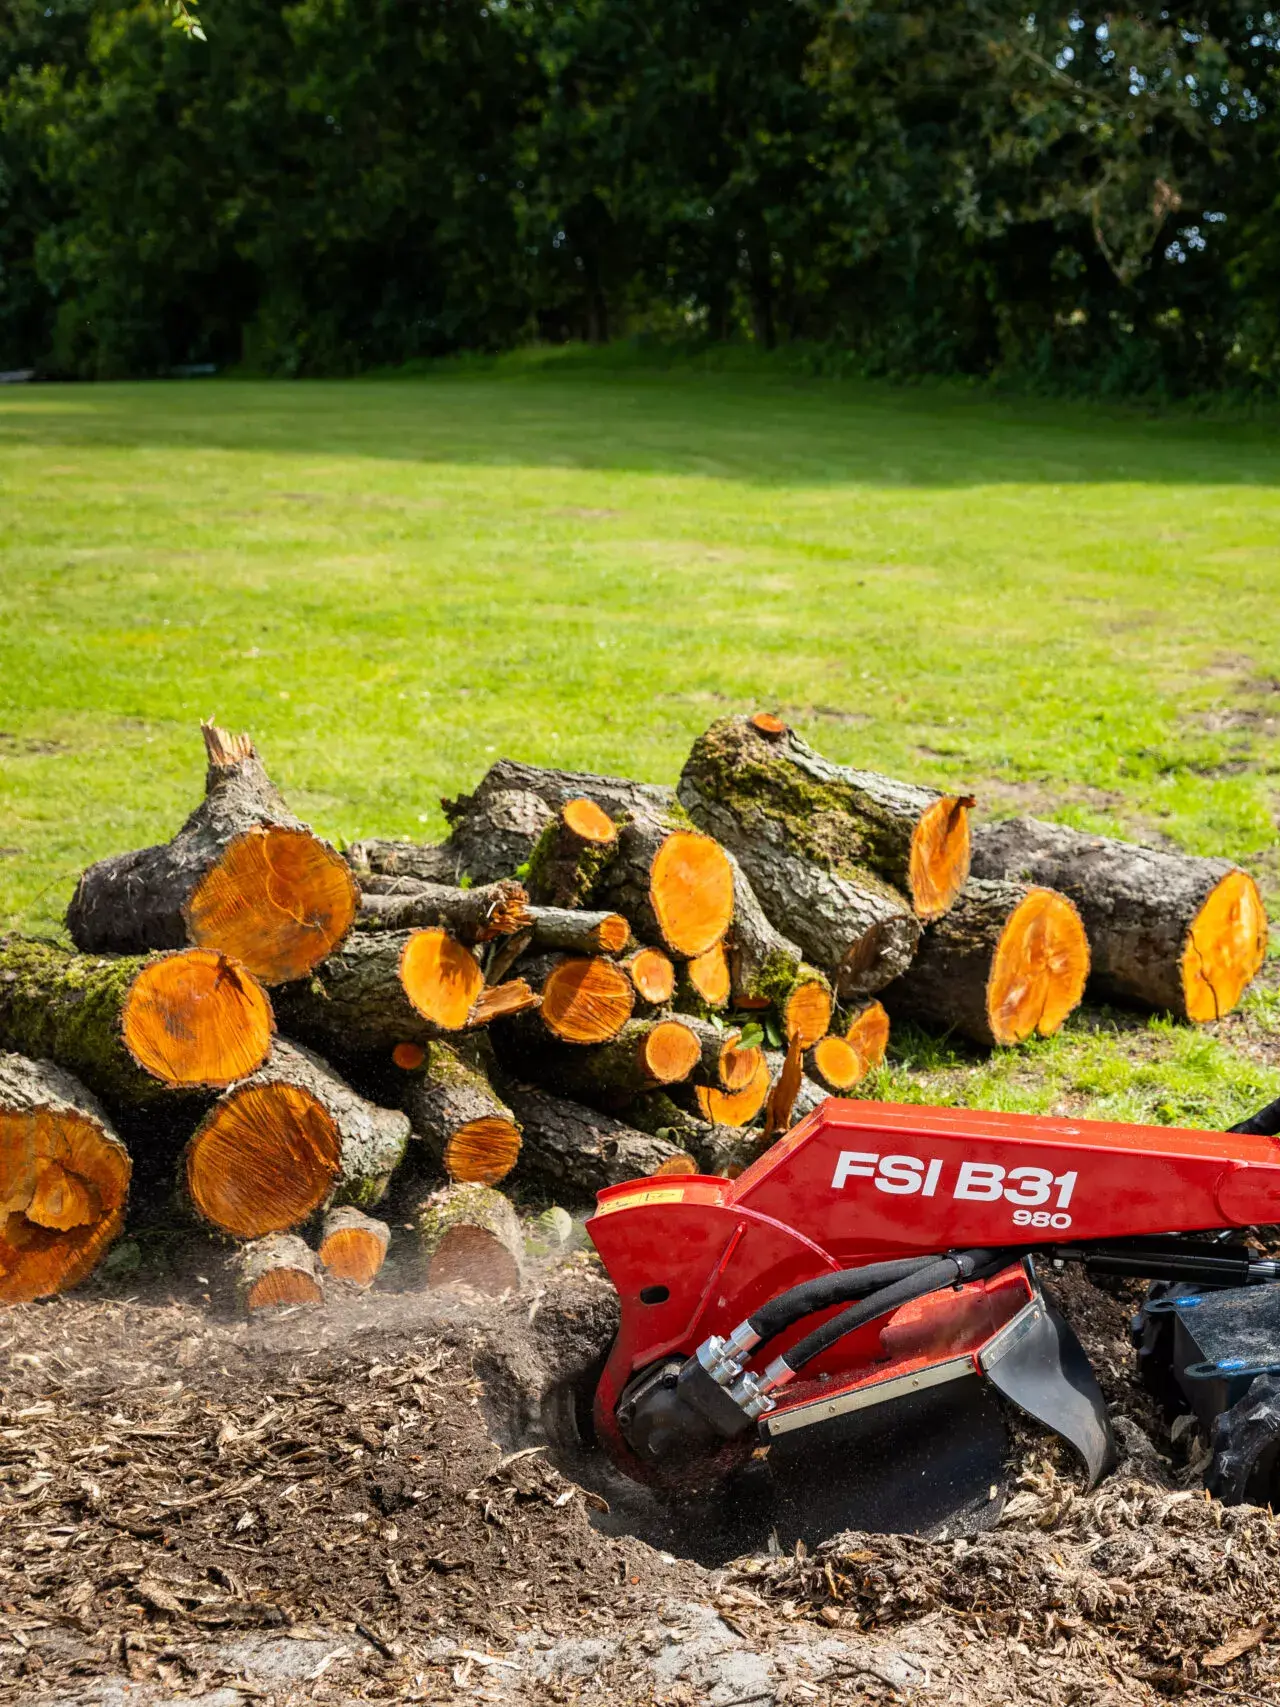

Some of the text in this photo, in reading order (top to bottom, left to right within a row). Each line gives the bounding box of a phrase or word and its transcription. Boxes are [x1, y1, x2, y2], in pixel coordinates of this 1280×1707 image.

[831, 1151, 1078, 1209] FSI B31
[1012, 1209, 1072, 1229] 980
